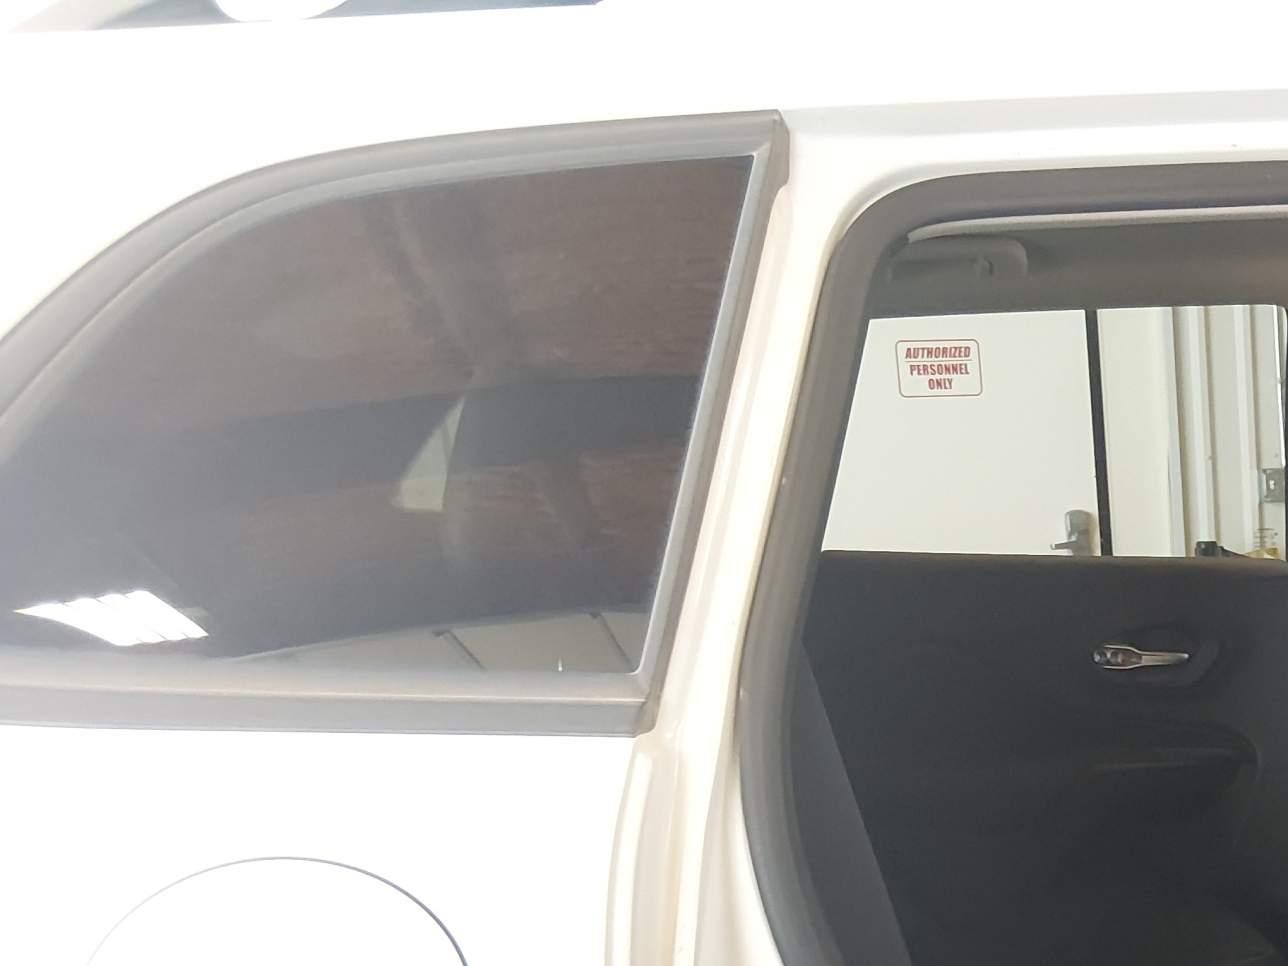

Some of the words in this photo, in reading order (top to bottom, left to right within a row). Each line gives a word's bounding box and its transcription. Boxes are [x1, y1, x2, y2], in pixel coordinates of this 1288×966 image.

[905, 346, 971, 359] AUTHORIZED
[909, 363, 970, 376] PERSONNEL
[928, 378, 953, 390] ONLY
